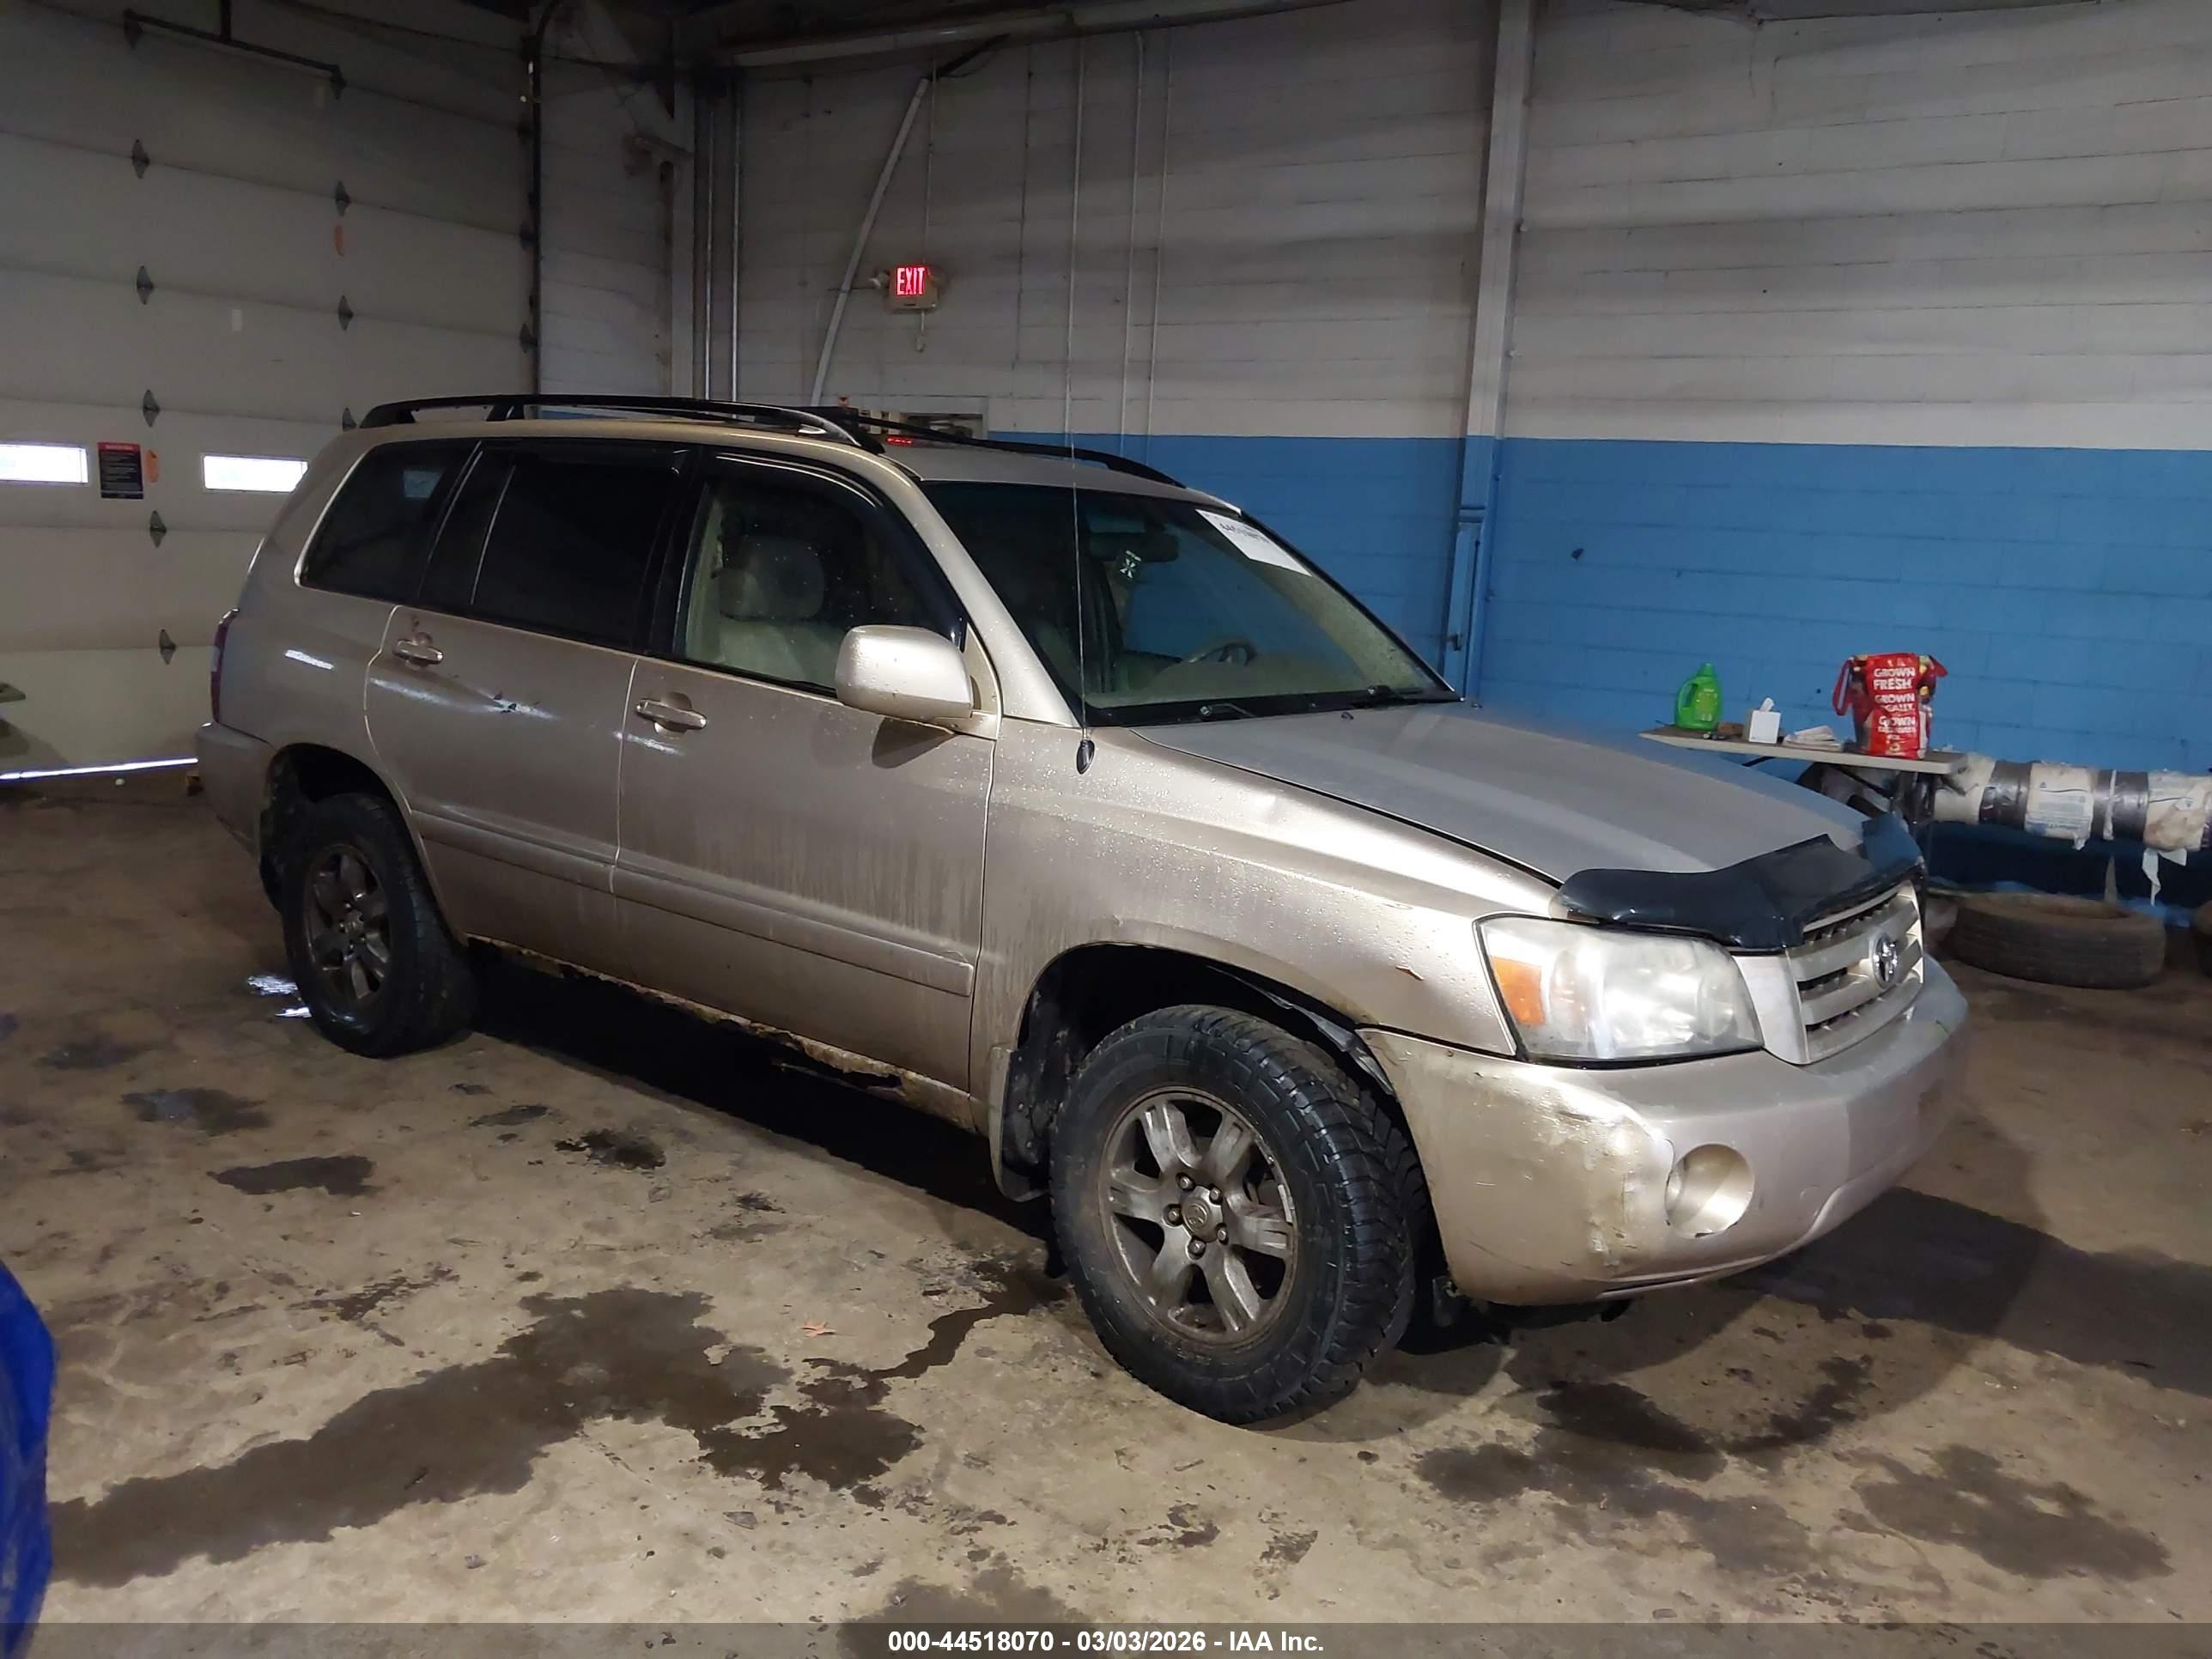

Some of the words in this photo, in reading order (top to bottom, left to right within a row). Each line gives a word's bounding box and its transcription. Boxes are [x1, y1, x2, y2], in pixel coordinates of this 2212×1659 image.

[897, 267, 926, 295] EXIT
[1874, 667, 1916, 678] GROWN
[1873, 678, 1912, 690] FRESH
[1875, 693, 1916, 703] GROWN
